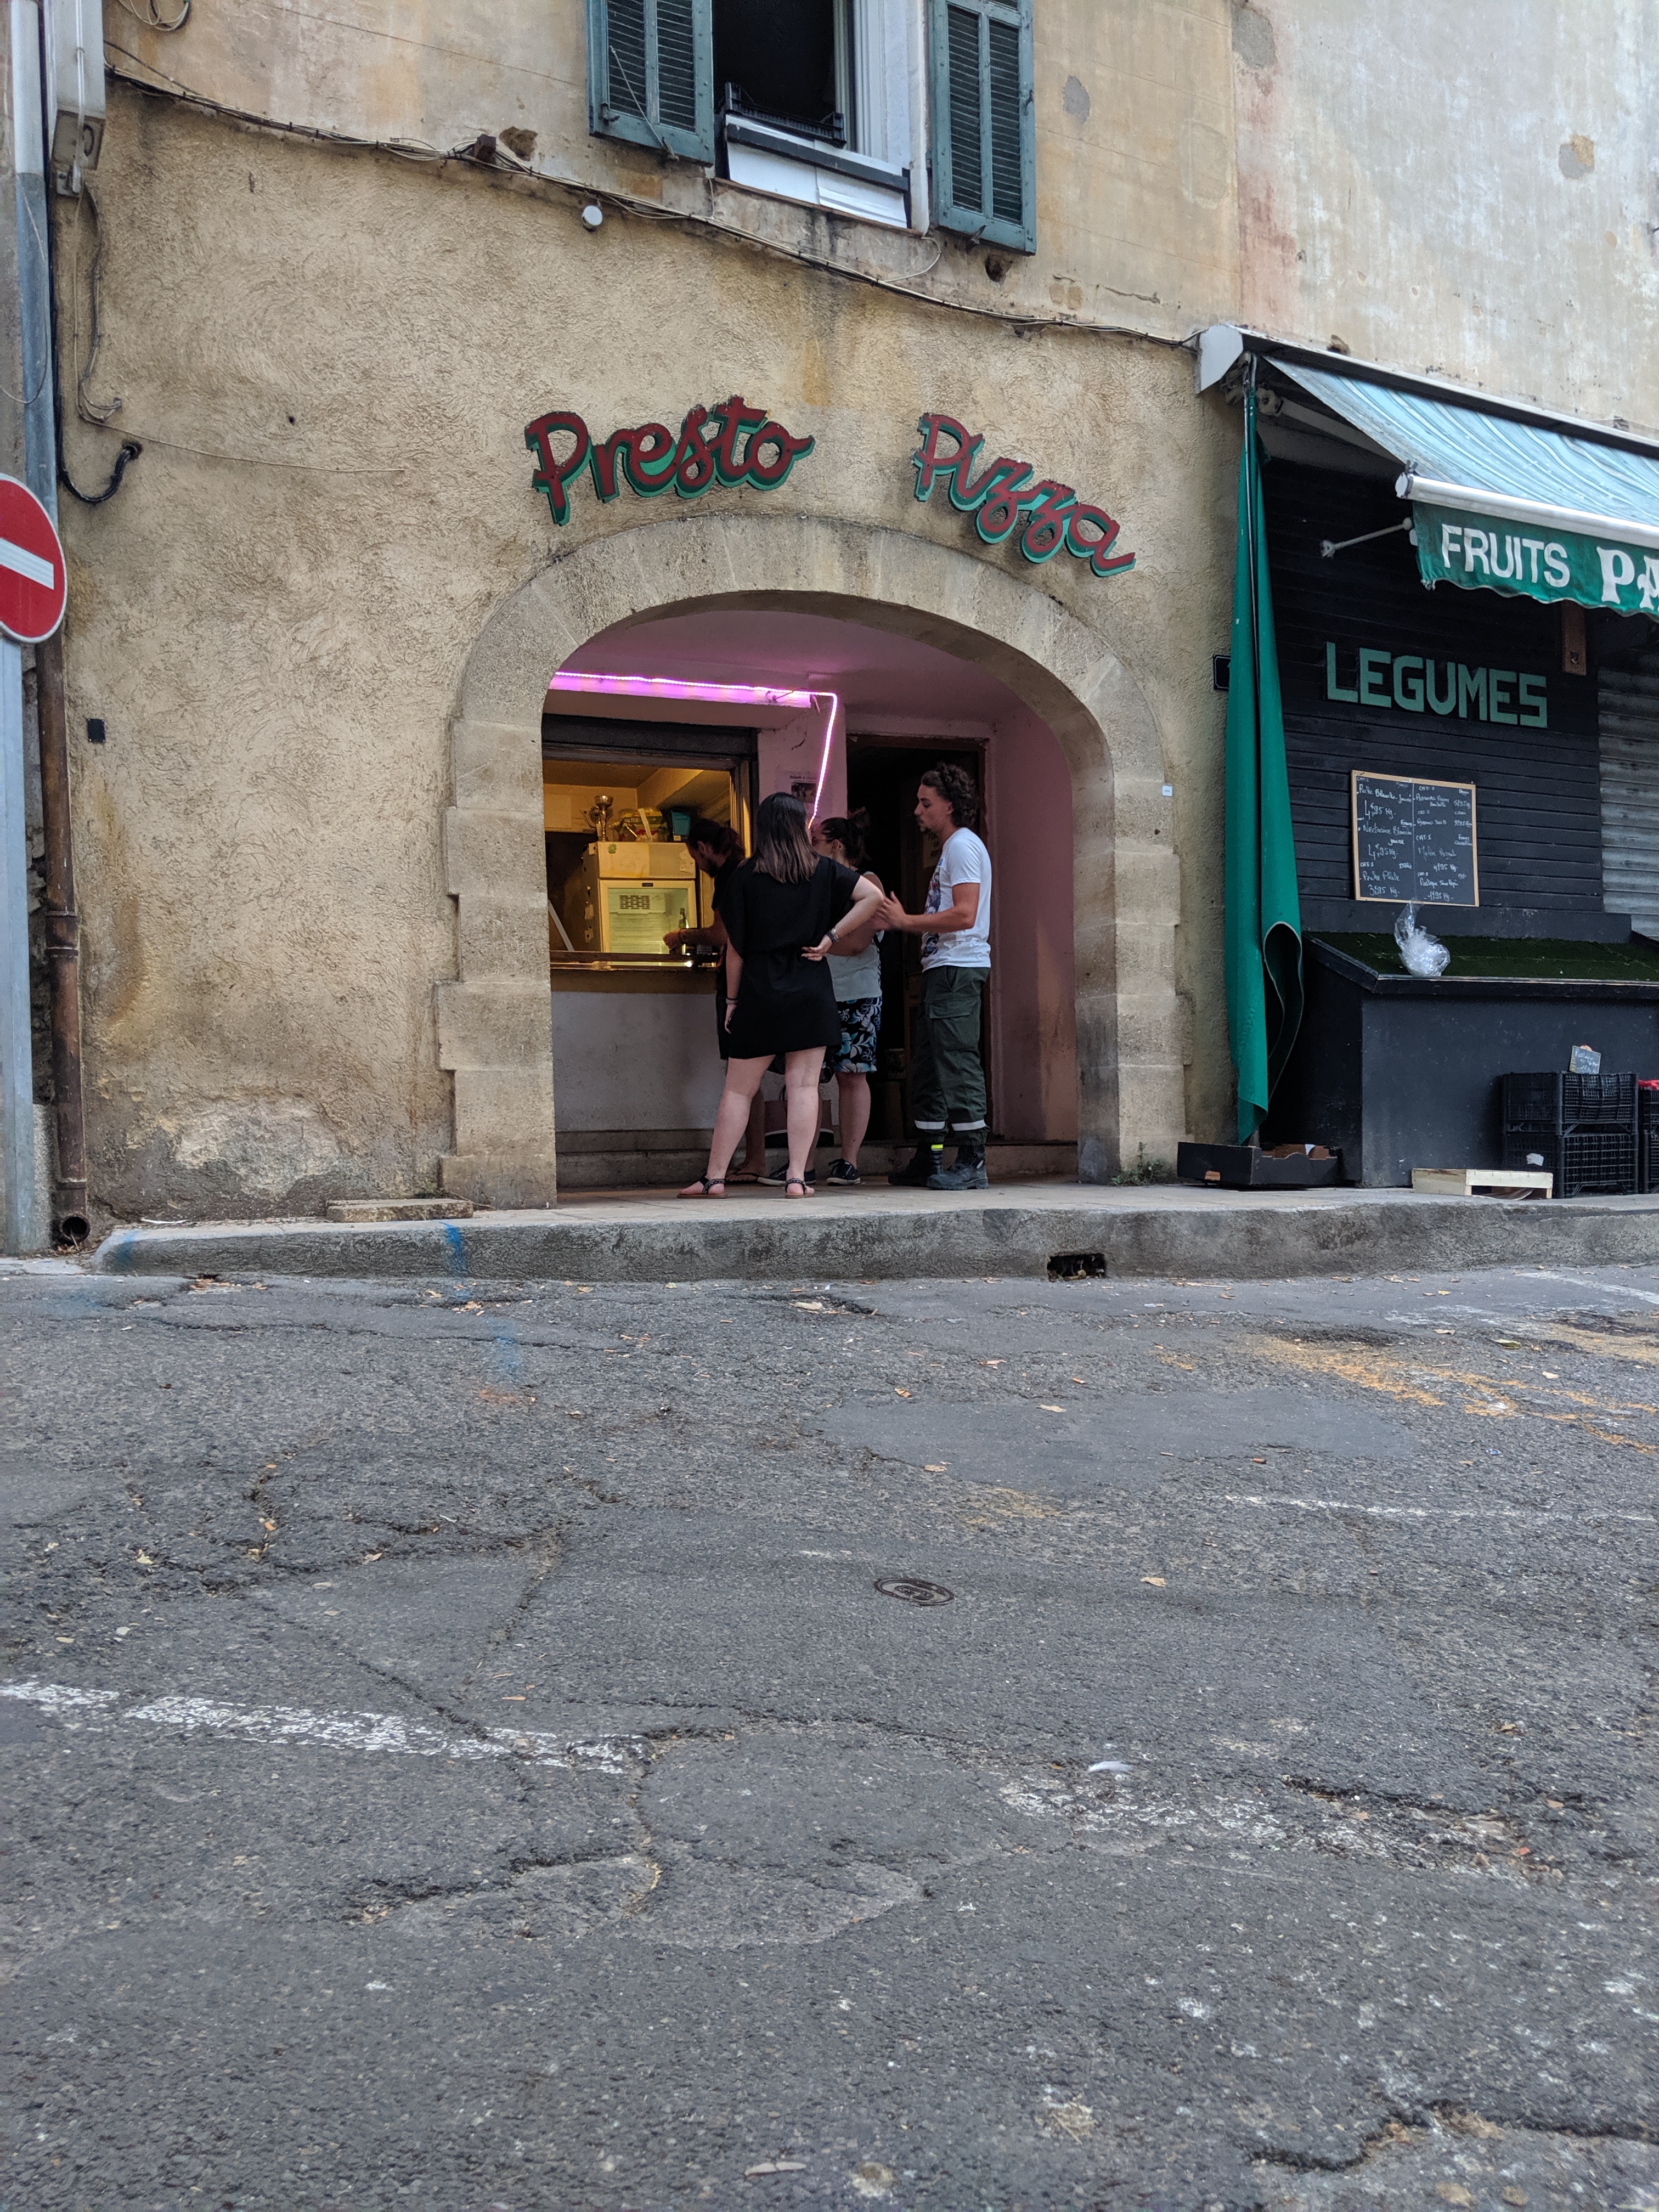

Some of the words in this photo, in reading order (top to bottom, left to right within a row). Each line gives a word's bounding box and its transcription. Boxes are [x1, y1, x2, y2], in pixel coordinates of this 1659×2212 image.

[524, 395, 815, 526] Presto
[913, 412, 1136, 577] Pizza
[1441, 523, 1570, 588] FRUITS
[1326, 641, 1548, 729] LEGUMES
